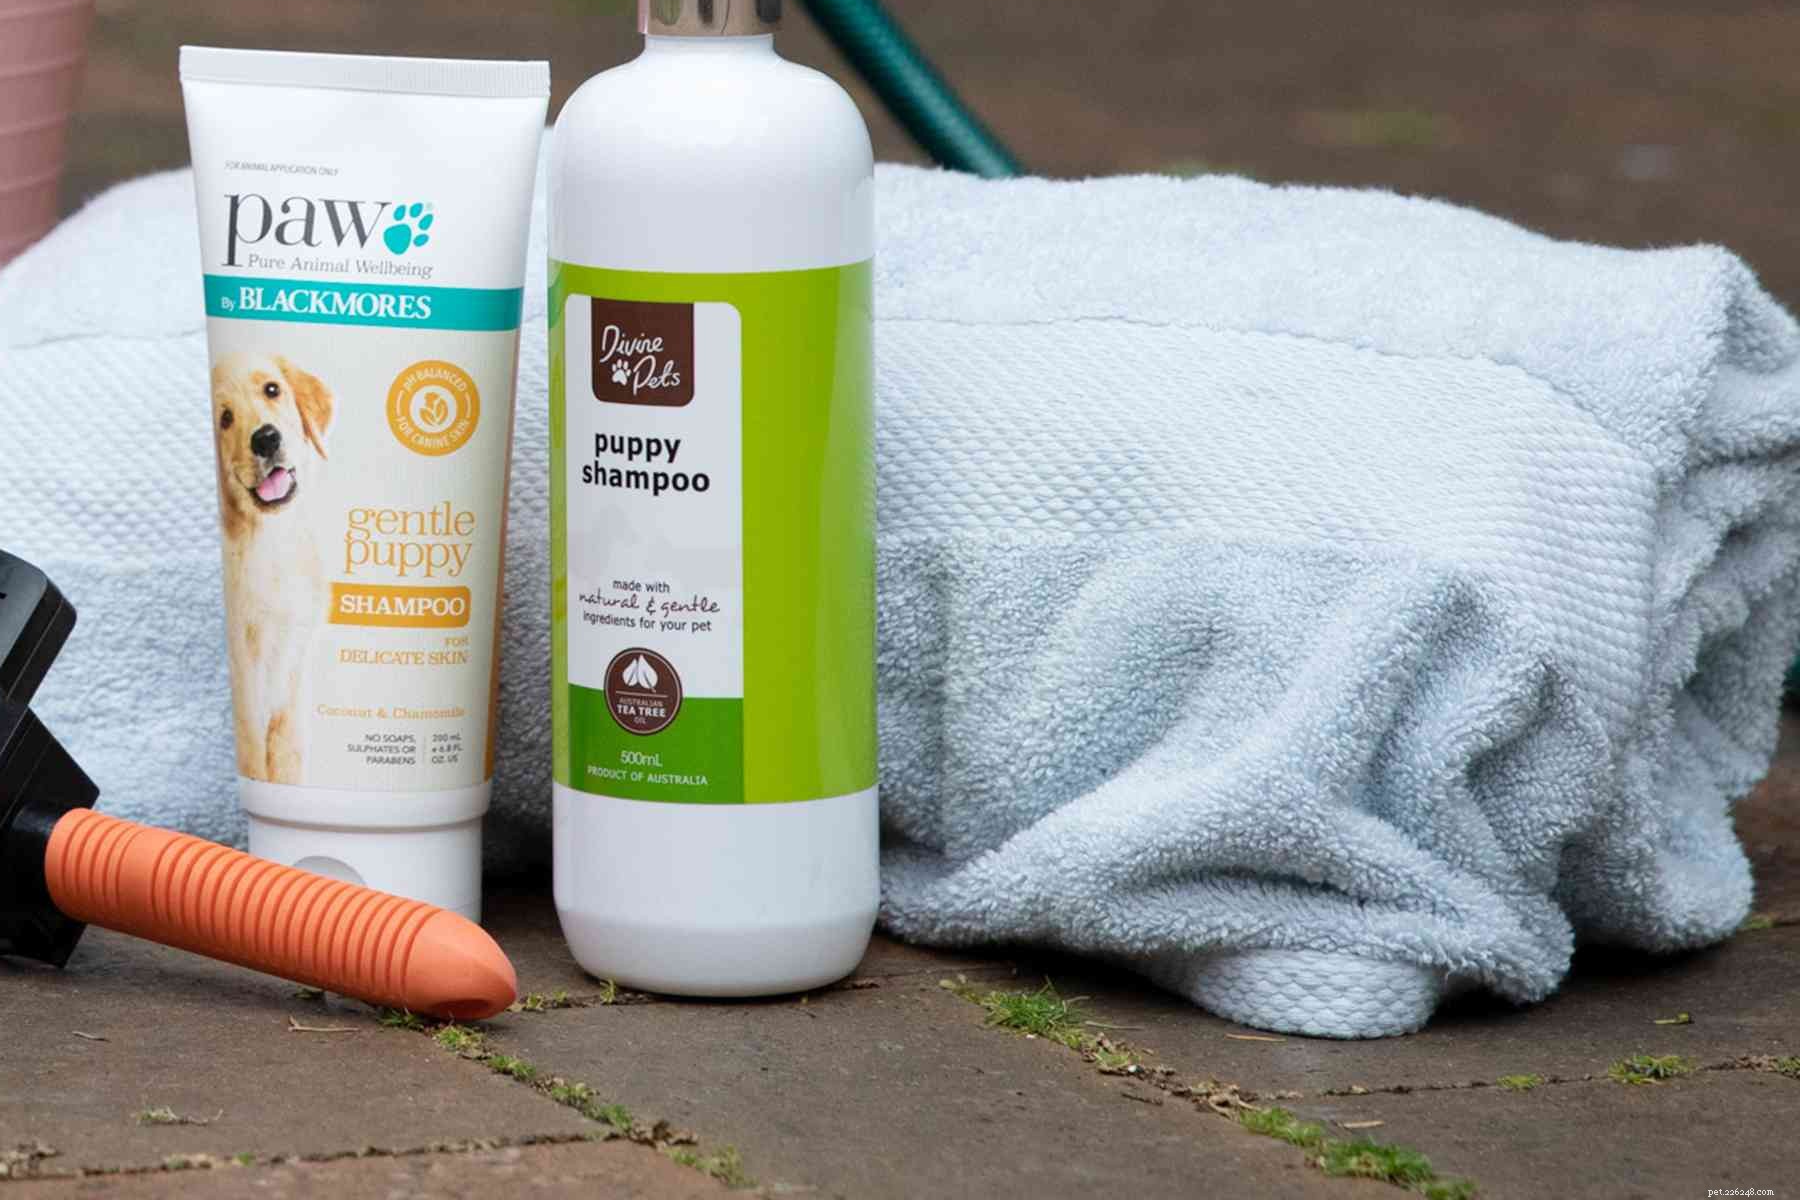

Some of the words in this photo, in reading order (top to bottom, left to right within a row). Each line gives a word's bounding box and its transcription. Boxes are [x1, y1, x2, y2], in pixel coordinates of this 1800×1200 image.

[221, 193, 392, 267] paw
[248, 254, 285, 270] Pure
[290, 257, 349, 273] Animal
[356, 259, 434, 279] Wellbeing
[221, 296, 236, 311] By
[239, 286, 432, 319] BLACKMORES
[599, 325, 664, 362] Divine
[632, 355, 681, 395] Pets
[594, 433, 681, 463] puppy
[582, 460, 711, 496] shampoo
[345, 500, 476, 542] gentle
[344, 538, 472, 578] puppy
[612, 579, 641, 592] made
[645, 581, 670, 593] with
[339, 594, 465, 616] SHAMPOO
[579, 587, 640, 609] natural
[646, 597, 657, 615] &
[661, 595, 720, 618] gentle
[583, 610, 636, 628] ingredients
[640, 617, 656, 629] for
[660, 620, 687, 632] your
[691, 620, 712, 632] pet
[445, 637, 469, 647] FOR
[339, 649, 424, 664] DELICATE
[428, 651, 468, 664] SKIN
[617, 704, 636, 716] TEA
[638, 706, 666, 718] TREE
[347, 744, 400, 753] SULPHATES
[401, 745, 416, 753] OR
[365, 734, 381, 742] NO
[432, 733, 448, 742] 200
[366, 756, 416, 765] PARABENS
[620, 750, 663, 767] 500mL
[587, 765, 628, 780] PRODUCT
[631, 771, 644, 781] OF
[647, 774, 708, 785] AUSTRALIA
